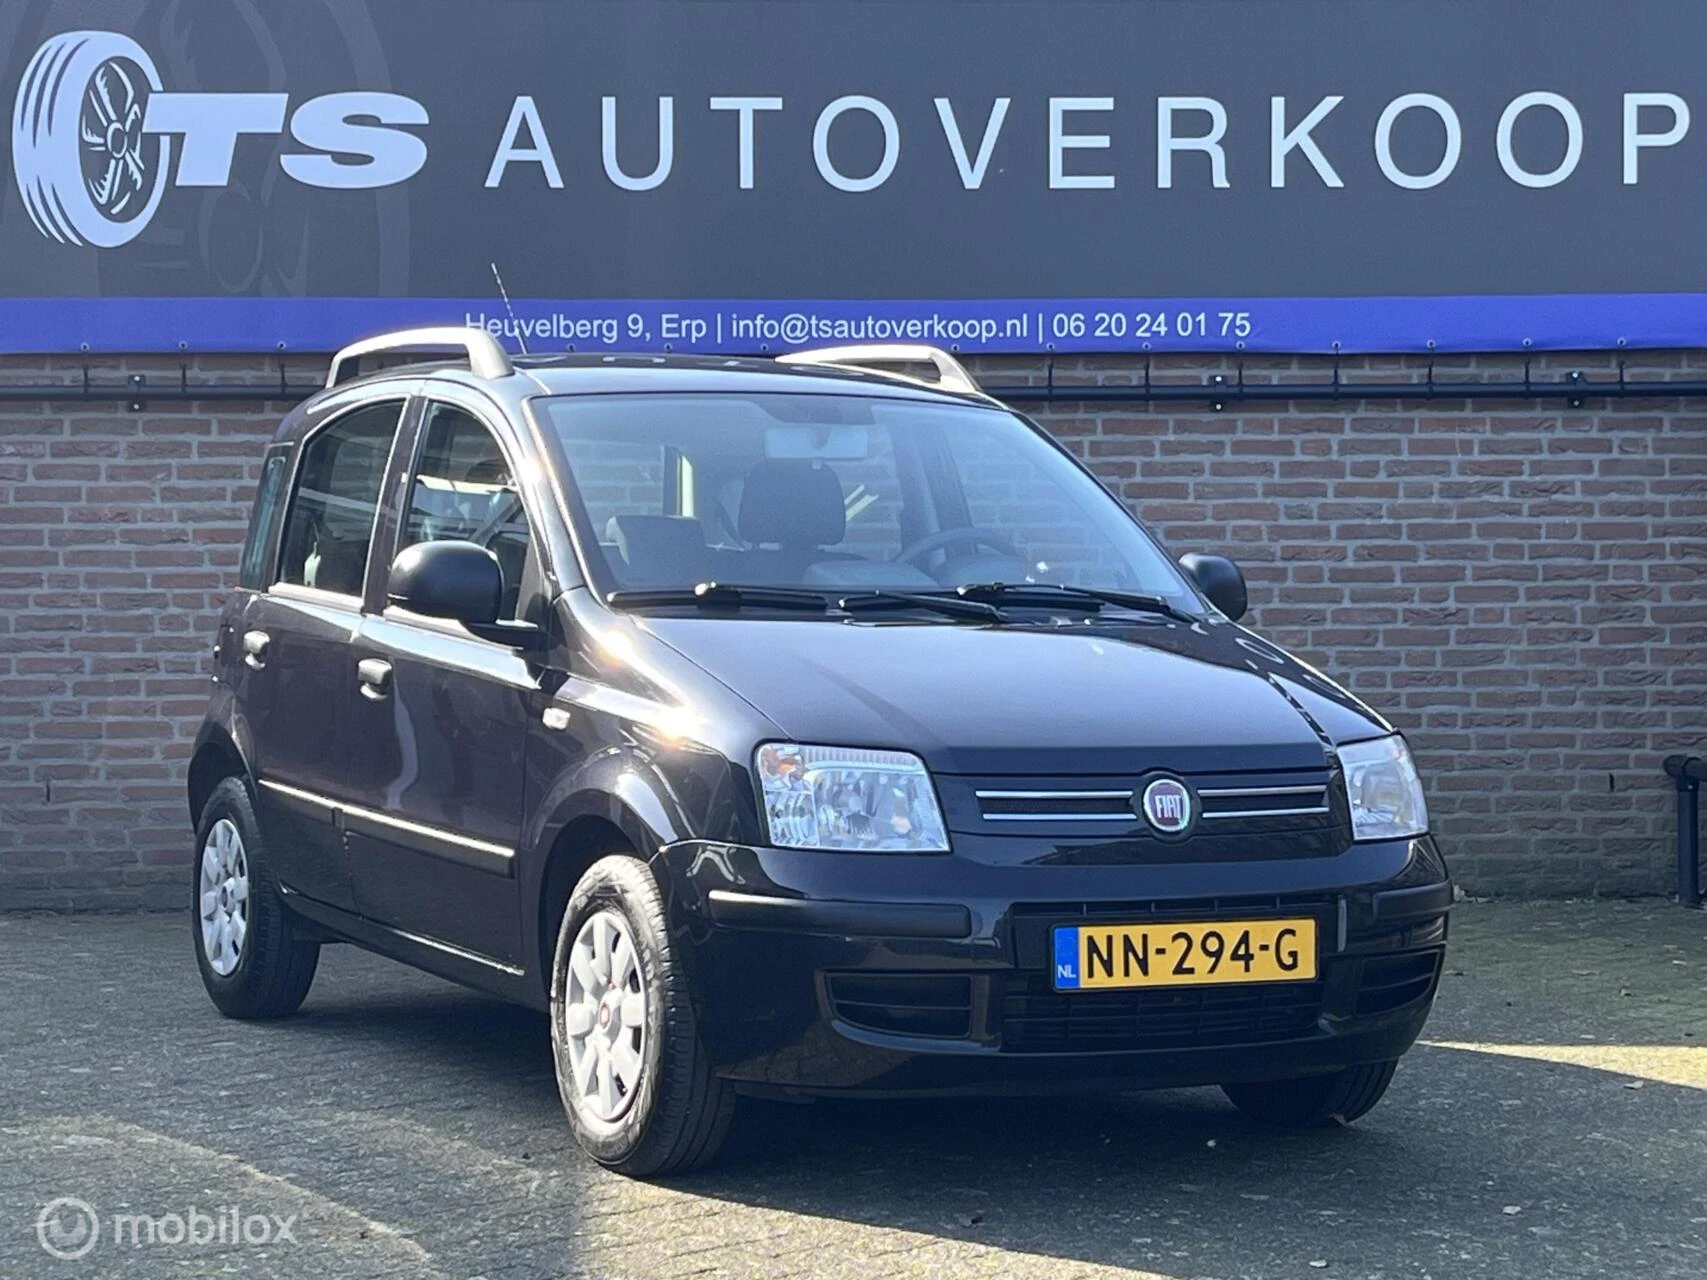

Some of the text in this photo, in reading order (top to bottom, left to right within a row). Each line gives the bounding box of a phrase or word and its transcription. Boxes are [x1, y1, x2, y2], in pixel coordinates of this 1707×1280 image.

[142, 91, 1692, 192] TS AUTOVERKOOP
[465, 312, 618, 343] Heuvelberg
[627, 313, 651, 341] 9,
[661, 314, 707, 342] Erp
[731, 312, 1028, 344] info@tsautoverkoop.nl
[1052, 313, 1085, 338] 06
[1094, 313, 1127, 337] 20
[1135, 313, 1168, 337] 24
[1176, 313, 1206, 337] 01
[1218, 312, 1252, 337] 75
[1154, 794, 1181, 819] FIAT
[1057, 928, 1299, 979] NL NN-294-G
